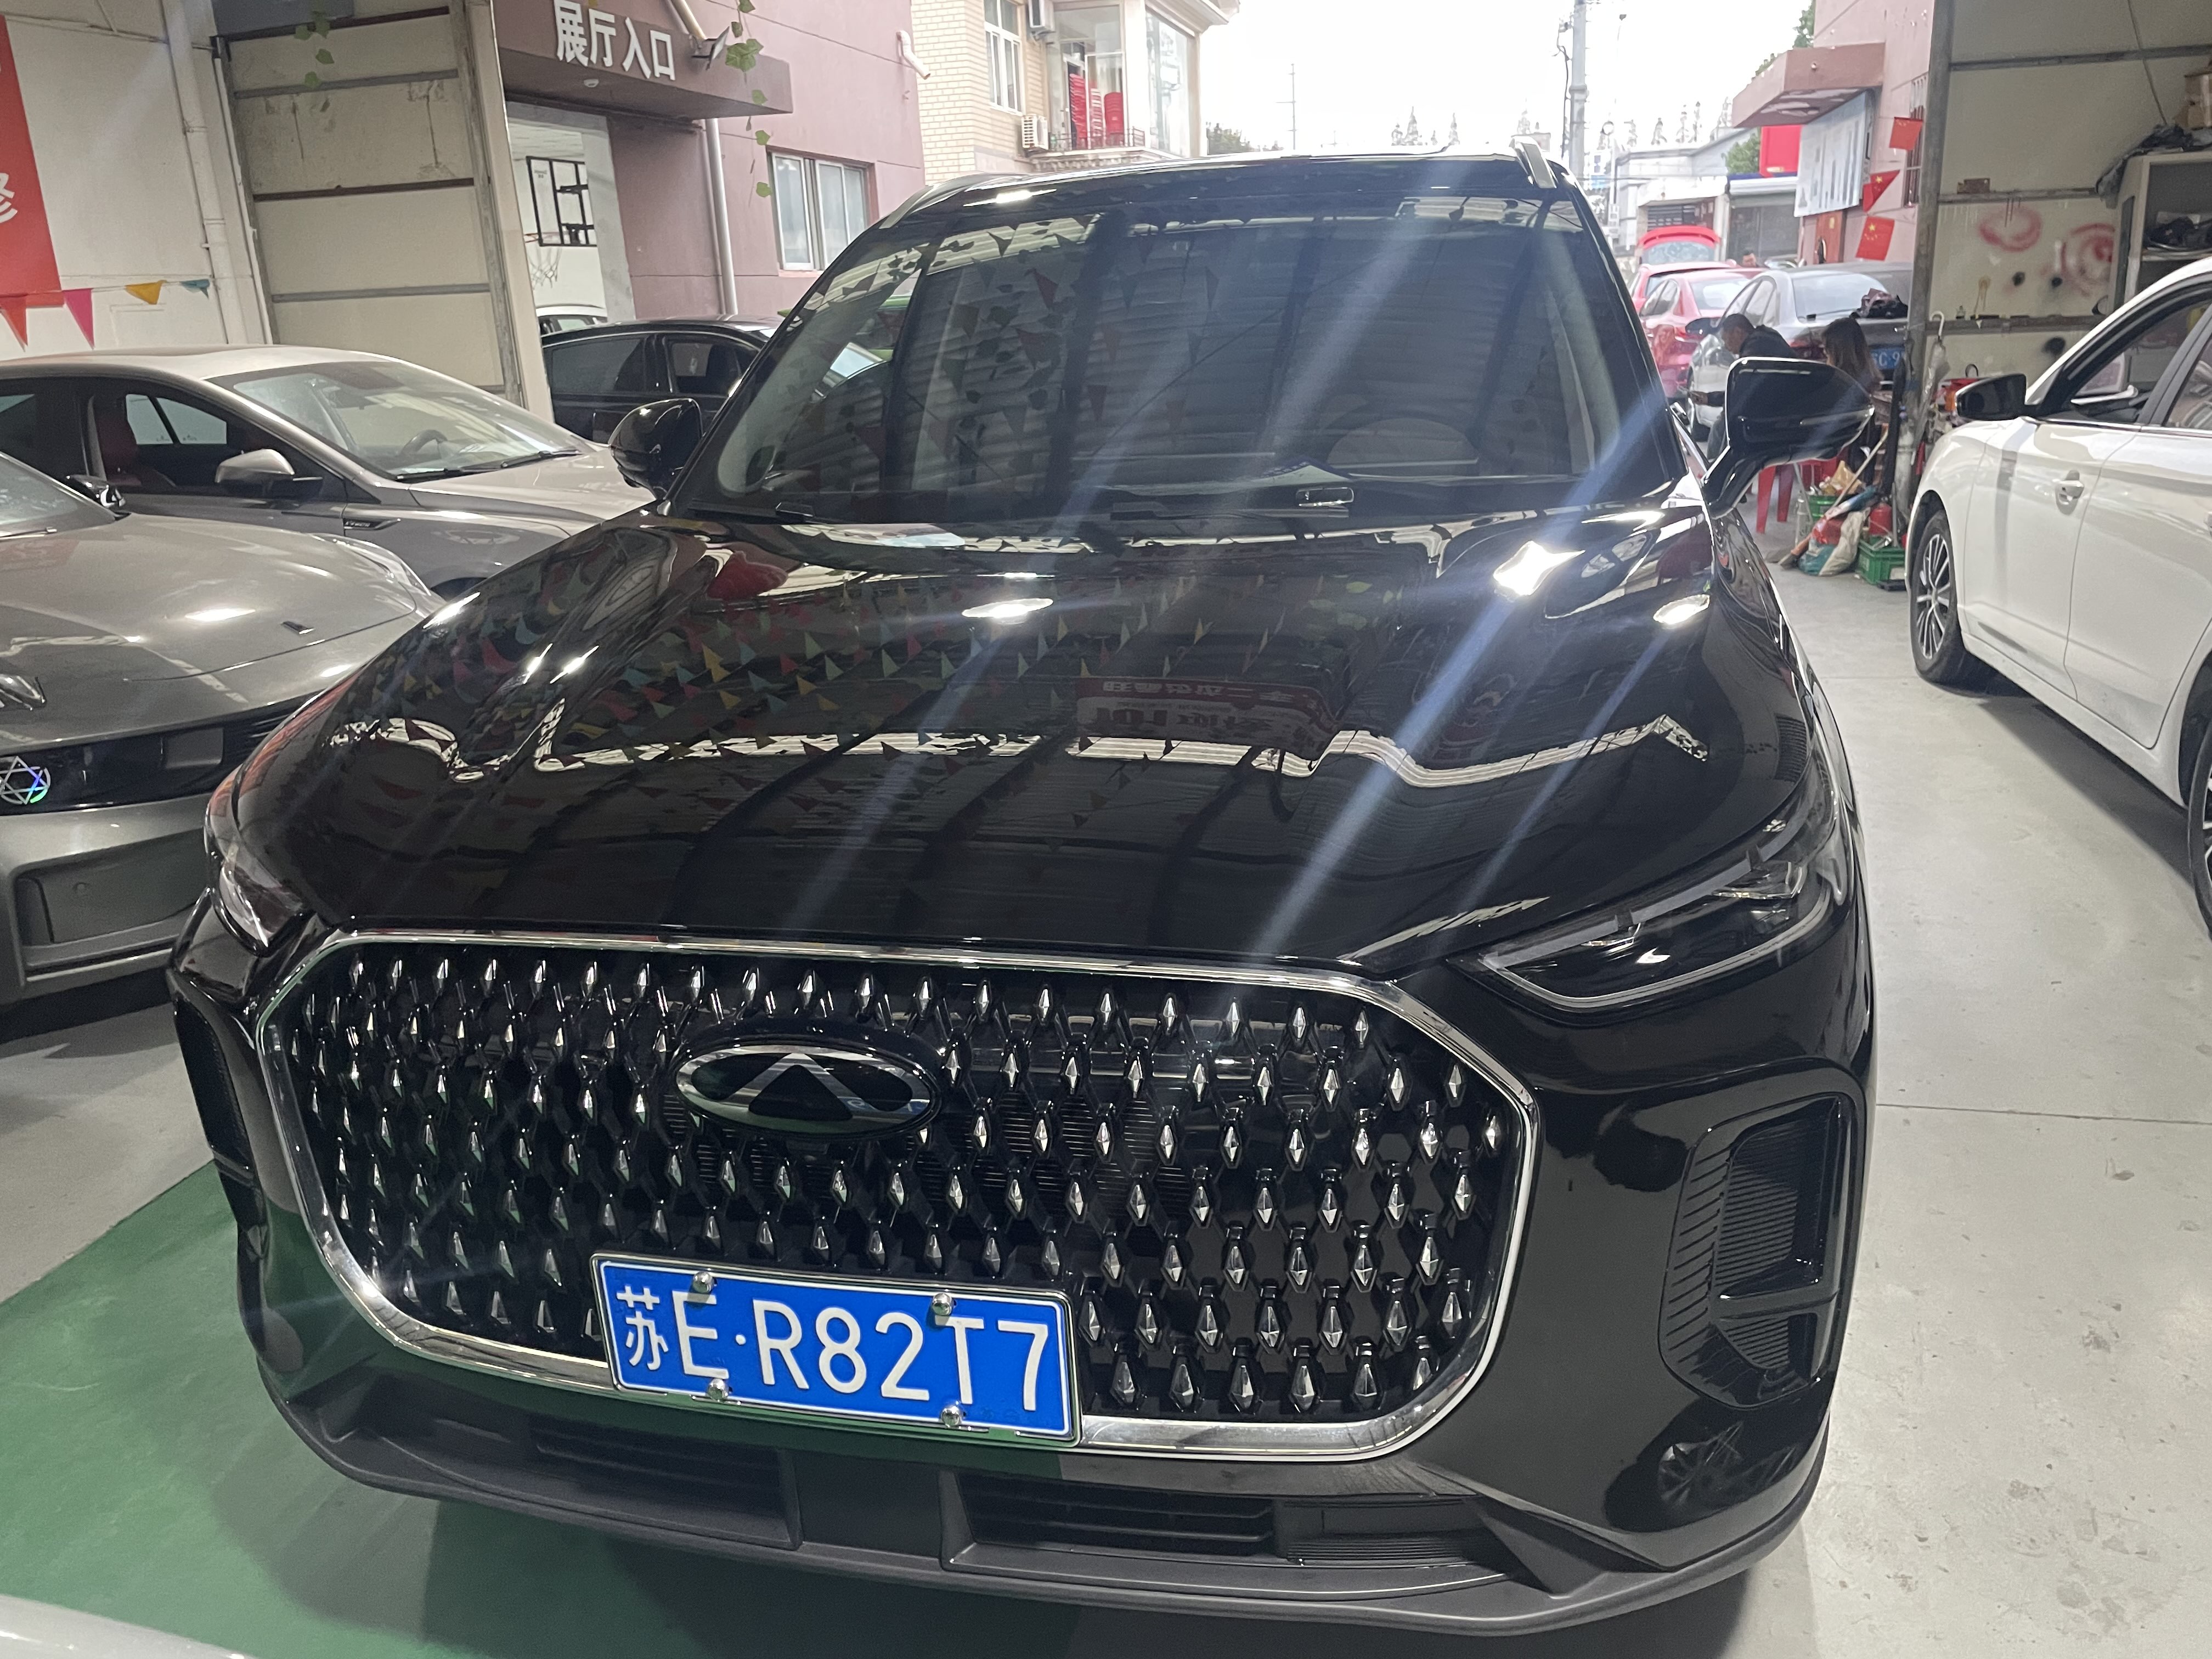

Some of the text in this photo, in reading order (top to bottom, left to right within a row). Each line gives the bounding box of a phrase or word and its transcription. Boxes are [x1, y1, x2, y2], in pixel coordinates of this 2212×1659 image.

[554, 0, 675, 80] 展厅入口
[617, 1285, 1049, 1411] 苏E·R82T7
